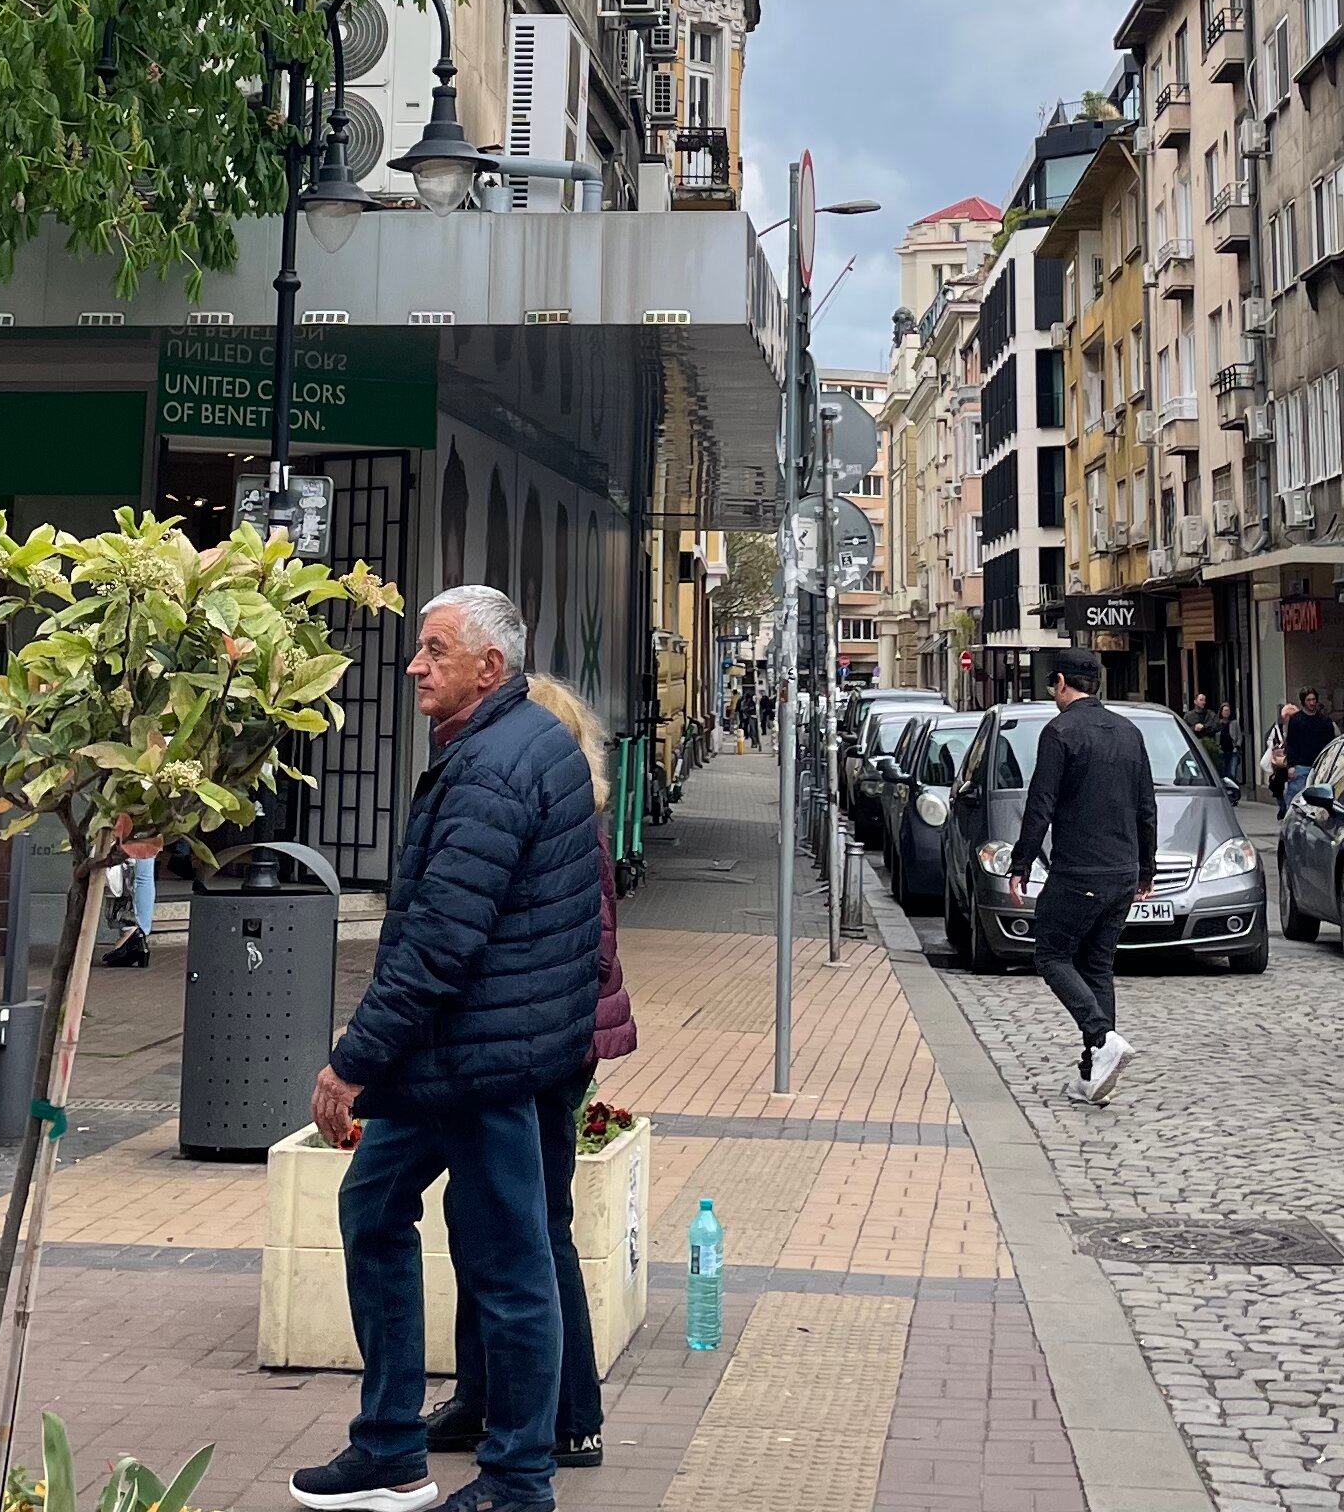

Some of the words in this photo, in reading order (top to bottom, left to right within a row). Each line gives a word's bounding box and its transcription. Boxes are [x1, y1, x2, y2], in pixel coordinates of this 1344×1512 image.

[164, 373, 251, 398] UNITED
[257, 379, 346, 405] CLORS
[163, 401, 194, 423] OF
[201, 403, 327, 431] BENETON.
[1152, 904, 1171, 919] MH
